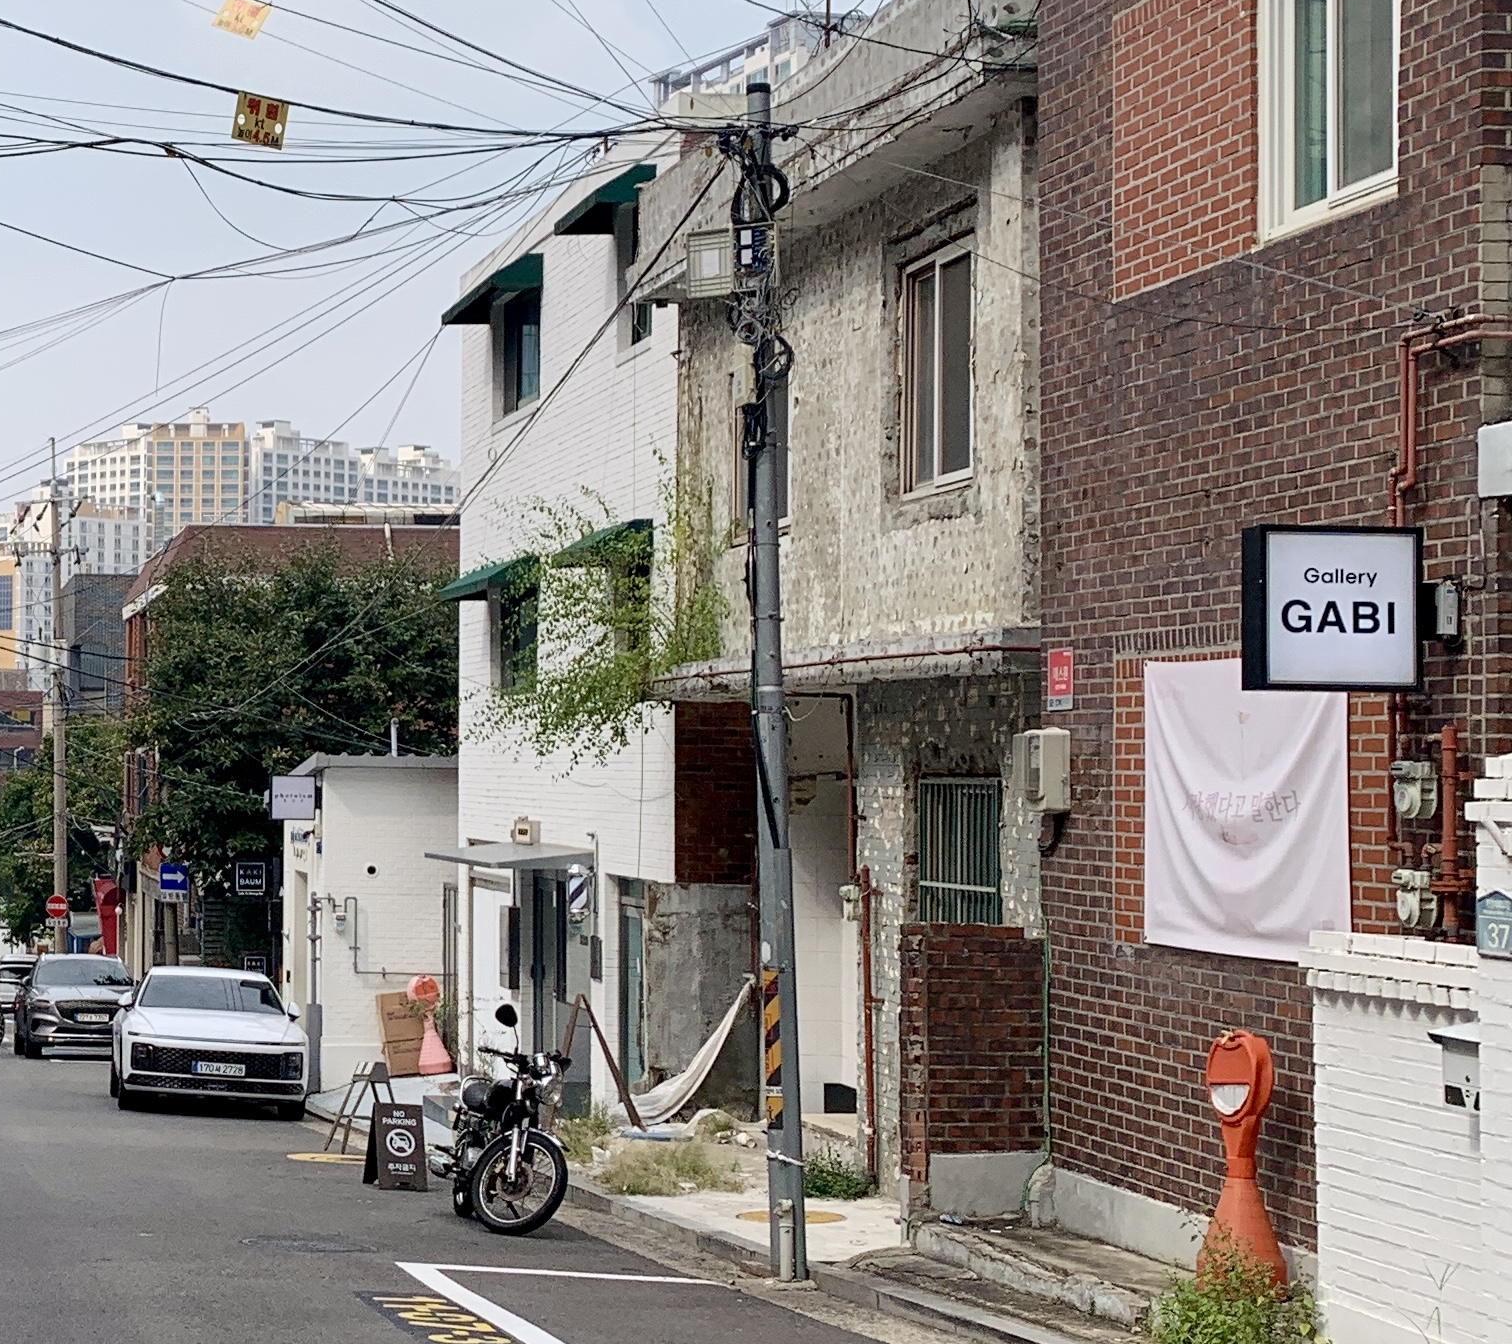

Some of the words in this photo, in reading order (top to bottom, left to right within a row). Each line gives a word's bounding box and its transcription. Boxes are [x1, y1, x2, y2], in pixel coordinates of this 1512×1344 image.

[1303, 567, 1378, 588] Gallery
[1280, 599, 1396, 635] GABI
[239, 878, 262, 886] BAUM
[1488, 922, 1511, 949] 37
[382, 1117, 417, 1126] PARKING
[392, 1110, 406, 1118] NO
